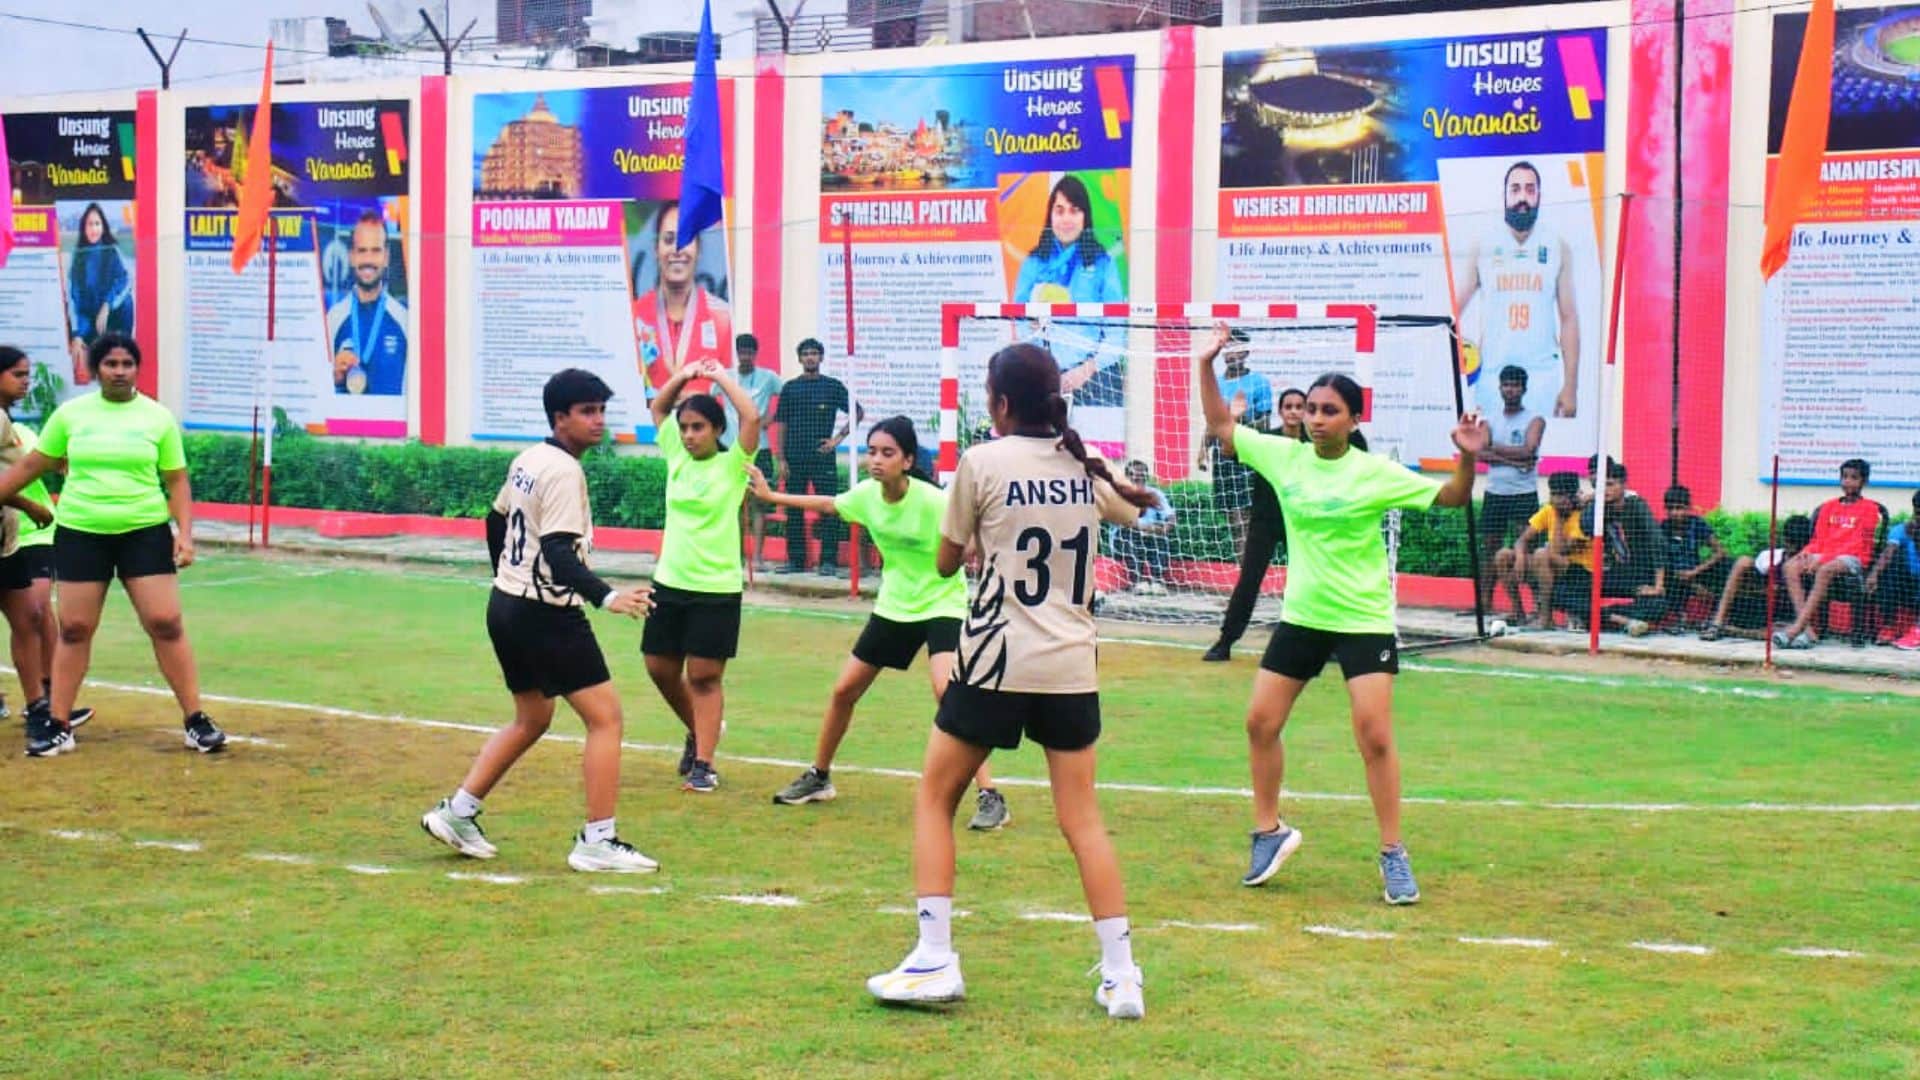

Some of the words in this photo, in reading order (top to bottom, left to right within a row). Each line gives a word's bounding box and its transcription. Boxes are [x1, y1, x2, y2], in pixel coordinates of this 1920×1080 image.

[1446, 38, 1545, 68] Unsung
[1004, 66, 1083, 94] Unsung
[1472, 70, 1542, 96] Heroes
[1026, 95, 1082, 118] Heroes
[58, 117, 110, 138] Unsung
[317, 107, 376, 130] Unsung
[1422, 106, 1541, 138] Varanasi
[73, 138, 110, 156] Heroes
[335, 131, 376, 150] Heroes
[985, 127, 1081, 154] Varanasi
[47, 163, 109, 186] Varanasi
[305, 157, 375, 181] Varanasi
[918, 199, 987, 225] PATHAK
[1233, 197, 1300, 217] VISHESH
[1304, 192, 1427, 215] BHRIGUVANSHI
[190, 214, 227, 237] LALIT
[480, 206, 551, 231] POONAM
[555, 206, 610, 230] YADAV
[1230, 243, 1256, 257] Life
[1260, 242, 1313, 258] Journey
[1318, 242, 1330, 255] &
[1336, 240, 1433, 256] Achievements
[1818, 230, 1889, 249] Journey
[1897, 227, 1912, 244] &
[505, 252, 540, 267] Journey
[556, 252, 621, 266] Achievements
[854, 252, 896, 267] Journey
[900, 252, 910, 265] &
[914, 252, 992, 266] Achievements
[1509, 303, 1529, 330] 09
[1014, 526, 1089, 606] 31
